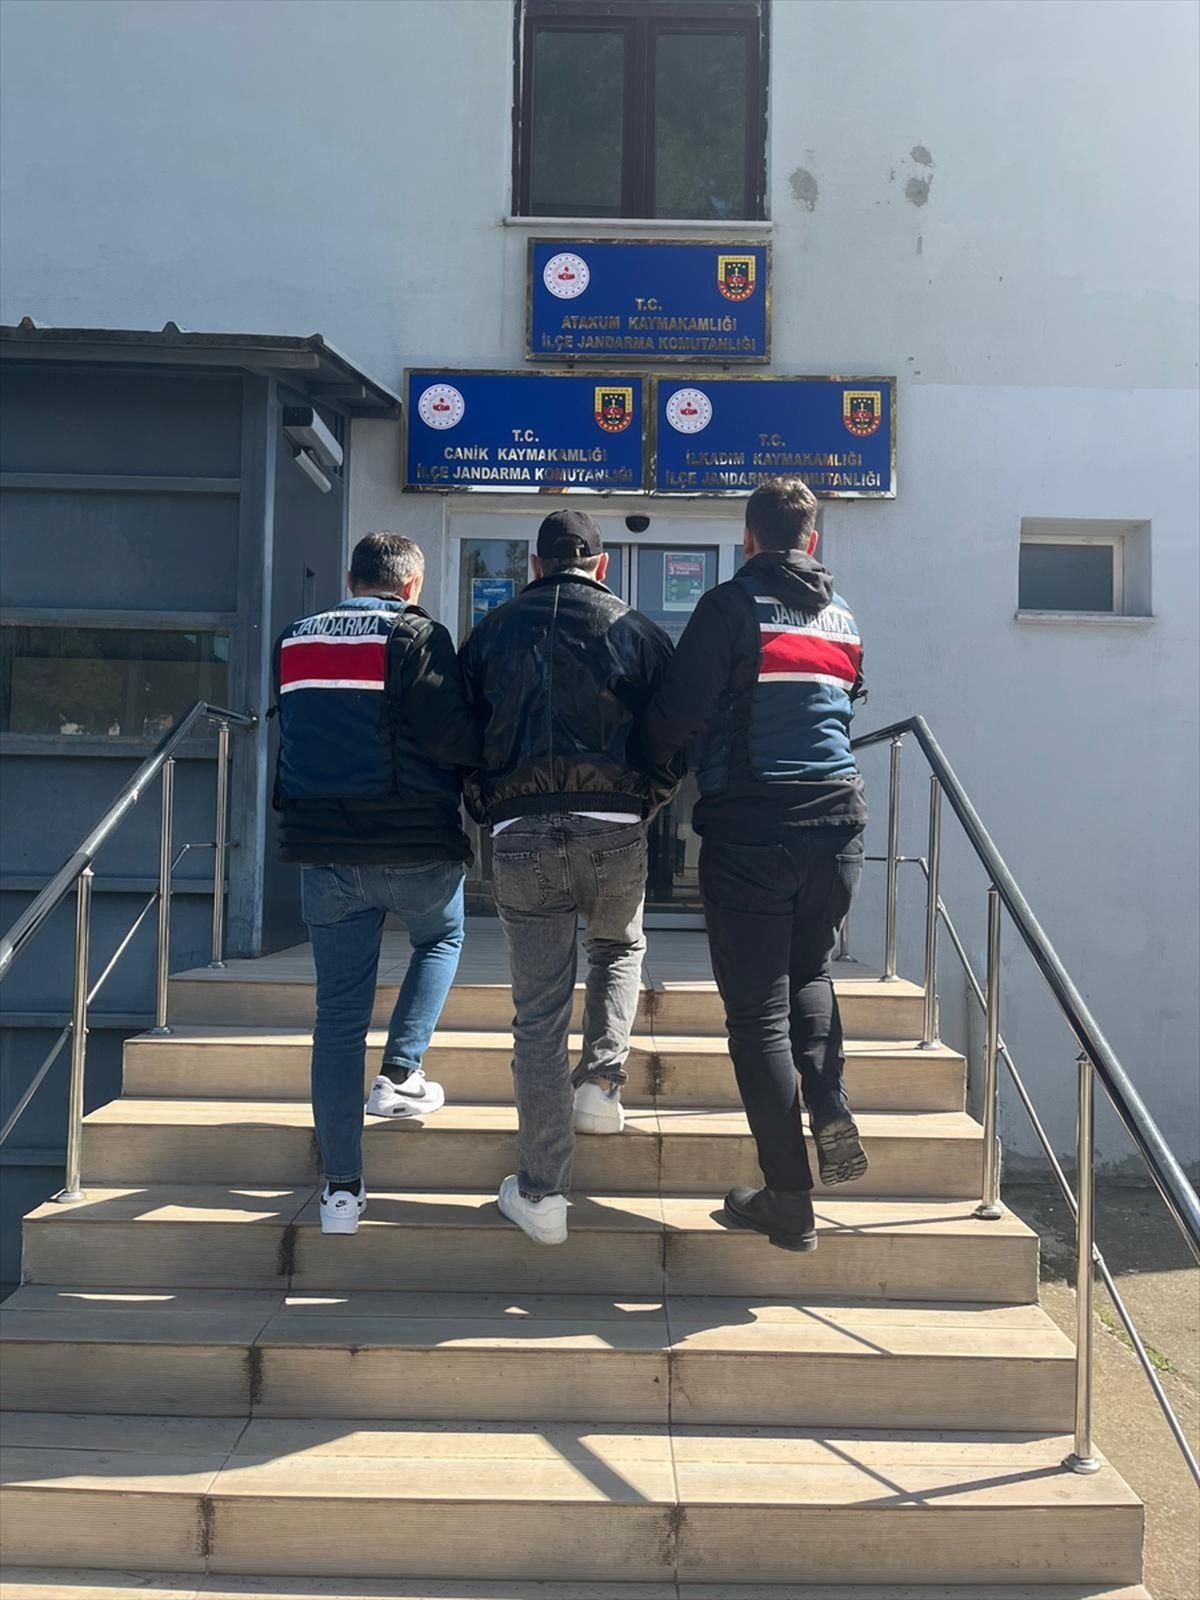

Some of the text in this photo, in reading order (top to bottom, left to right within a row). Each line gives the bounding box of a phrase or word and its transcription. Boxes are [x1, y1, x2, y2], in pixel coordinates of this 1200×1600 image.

[635, 298, 662, 310] T.C.
[561, 315, 737, 332] ATAKUM KAYMAKAMLIĞI
[541, 332, 756, 351] İLÇE JANDARMA KOMUTANLIĞI
[512, 429, 540, 442] T.C.
[758, 434, 786, 447] T.C.
[444, 444, 607, 463] CANİK KAYMAKAMLIĞI
[686, 450, 863, 467] İLKADIM KAYMAKAMLIĞI
[417, 463, 633, 482] İLÇE JANDARMA KOMUTANLIĞI
[665, 469, 697, 488] İLÇE
[292, 615, 379, 637] JANDARMA
